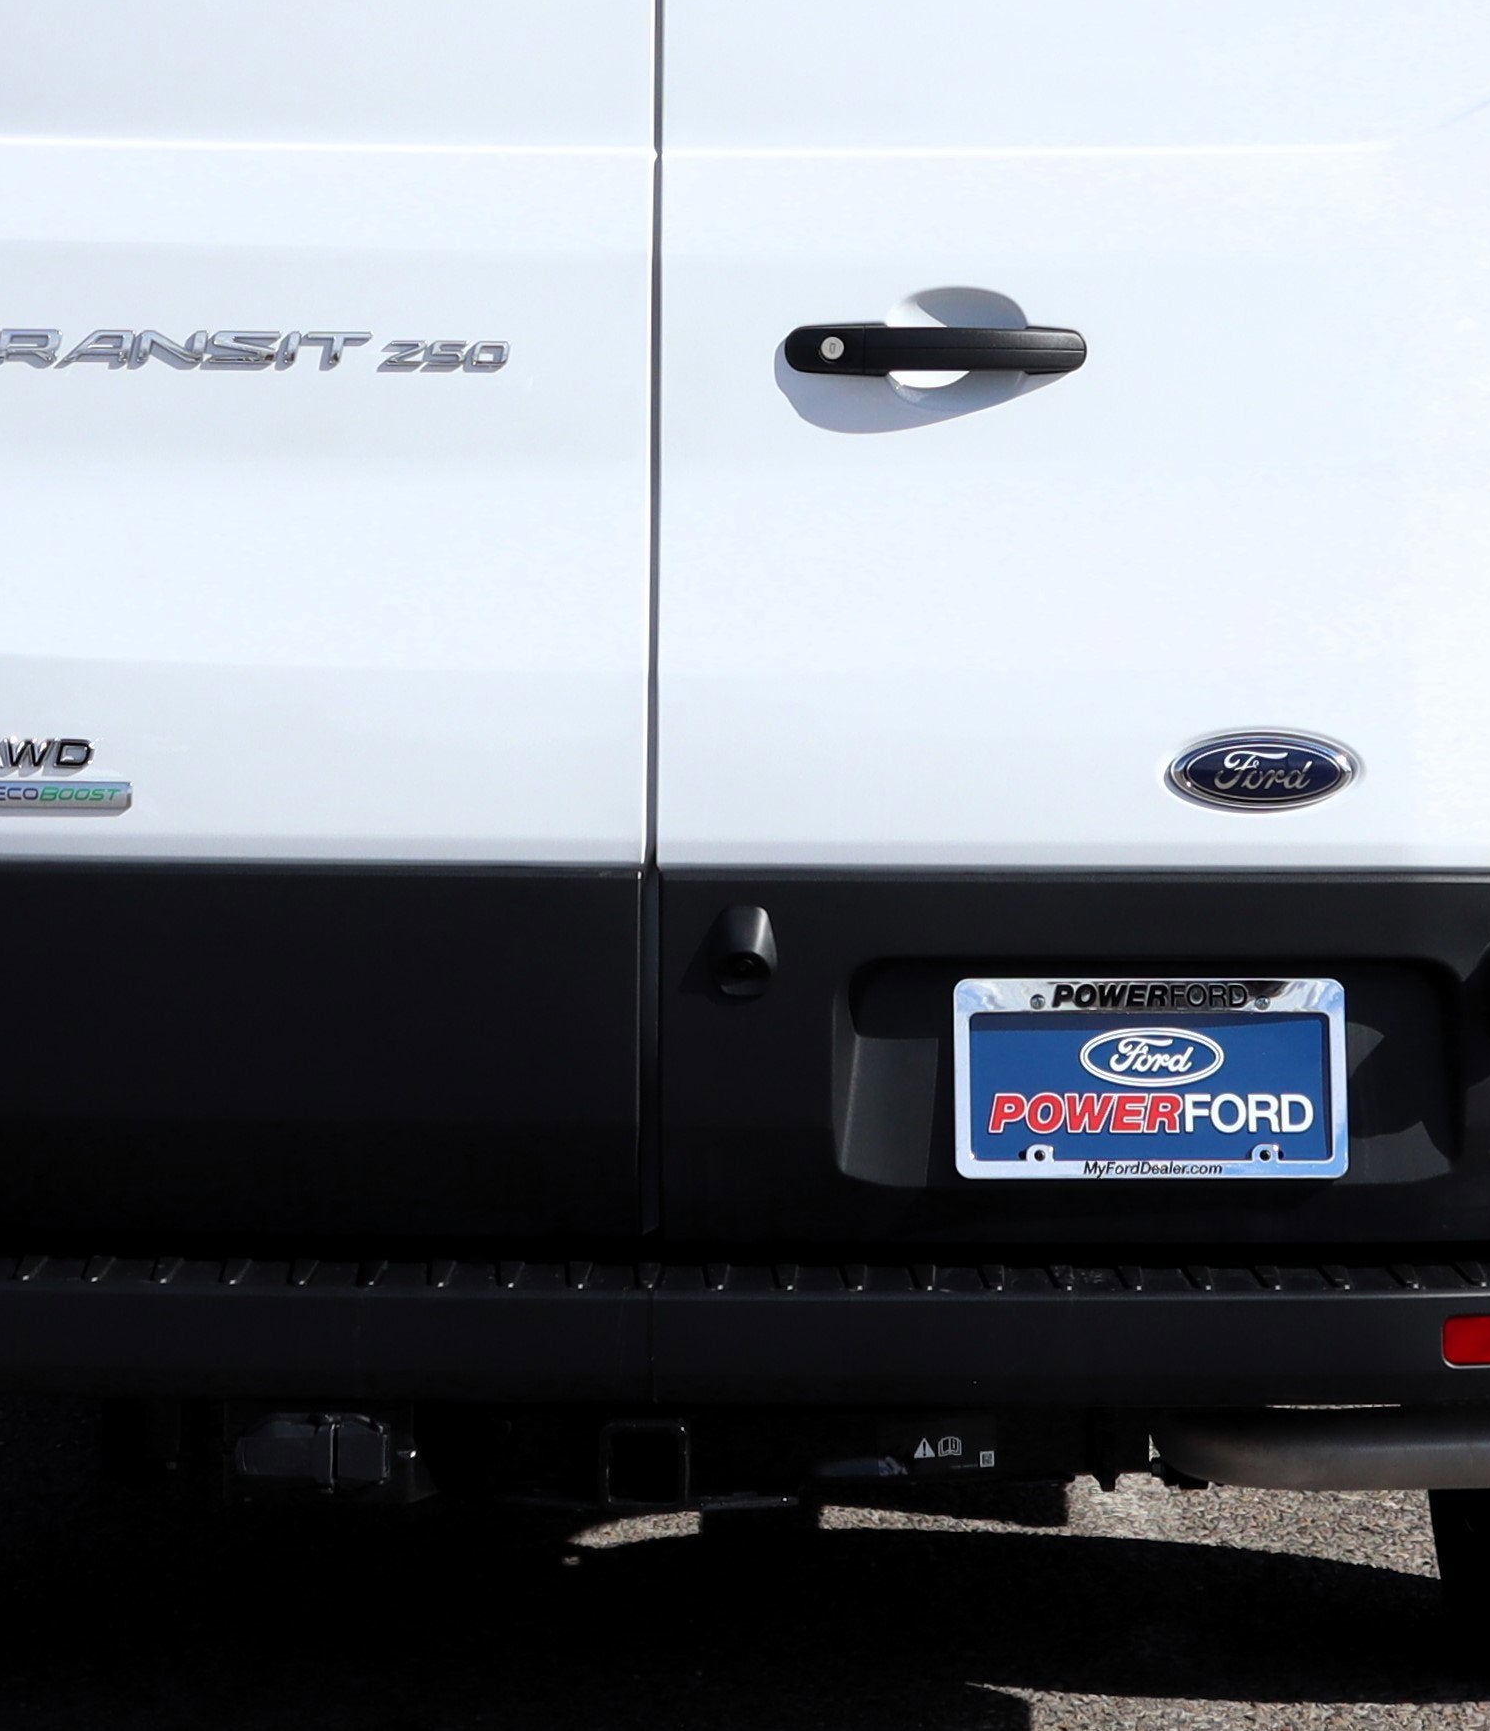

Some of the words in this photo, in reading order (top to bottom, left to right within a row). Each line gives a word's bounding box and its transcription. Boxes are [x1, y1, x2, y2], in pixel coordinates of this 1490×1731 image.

[383, 339, 512, 369] 250
[1213, 750, 1313, 790] Ford
[1051, 982, 1251, 1010] POWERFORD
[1109, 1036, 1194, 1074] Ford
[987, 1092, 1315, 1135] POWERFORD
[1083, 1159, 1224, 1177] MyFordDealer.com
